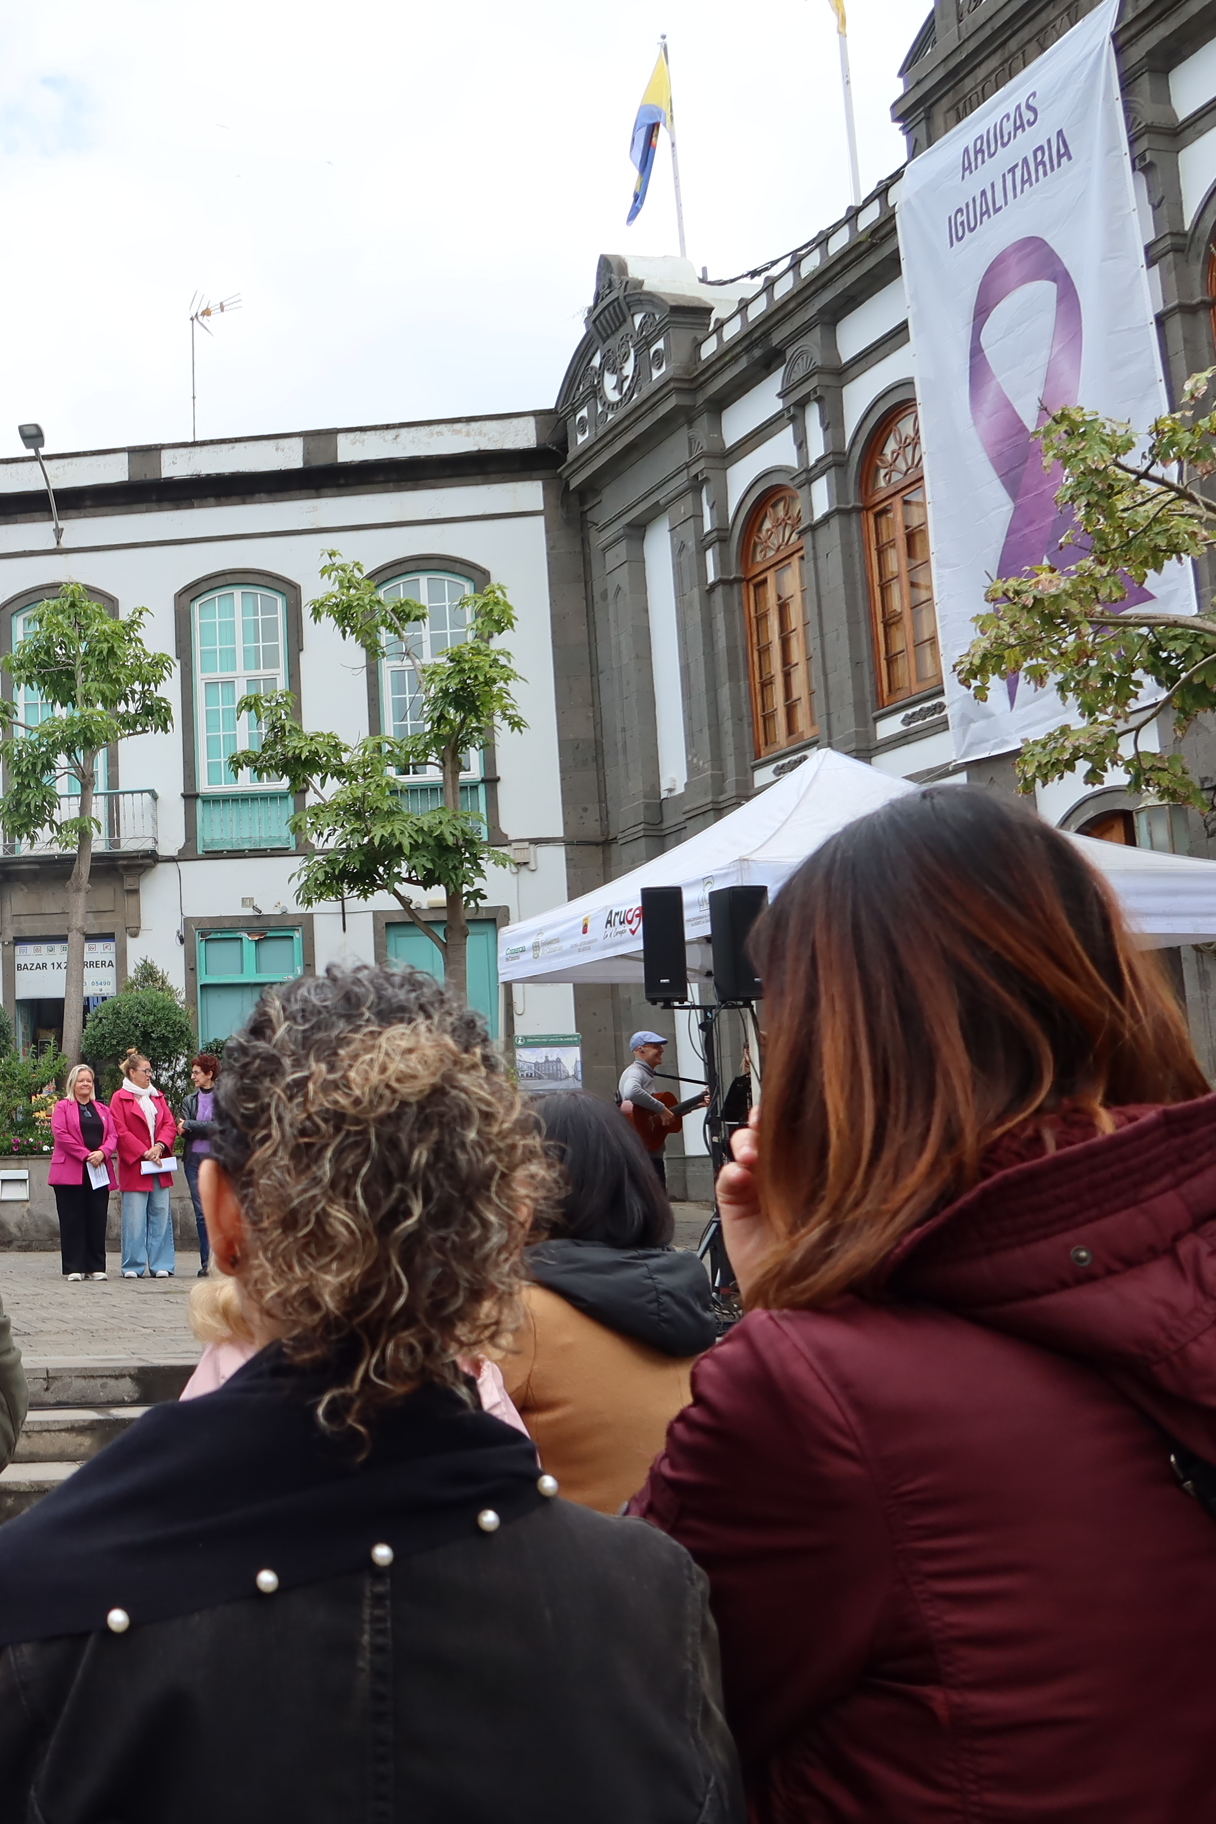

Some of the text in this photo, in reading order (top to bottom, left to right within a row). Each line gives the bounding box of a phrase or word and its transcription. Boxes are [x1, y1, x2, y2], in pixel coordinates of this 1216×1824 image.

[960, 90, 1039, 182] ARUCAS
[947, 128, 1073, 249] IGUALITARIA
[605, 905, 644, 936] Aruca
[16, 962, 48, 972] BAZAR
[83, 960, 115, 969] RRERA
